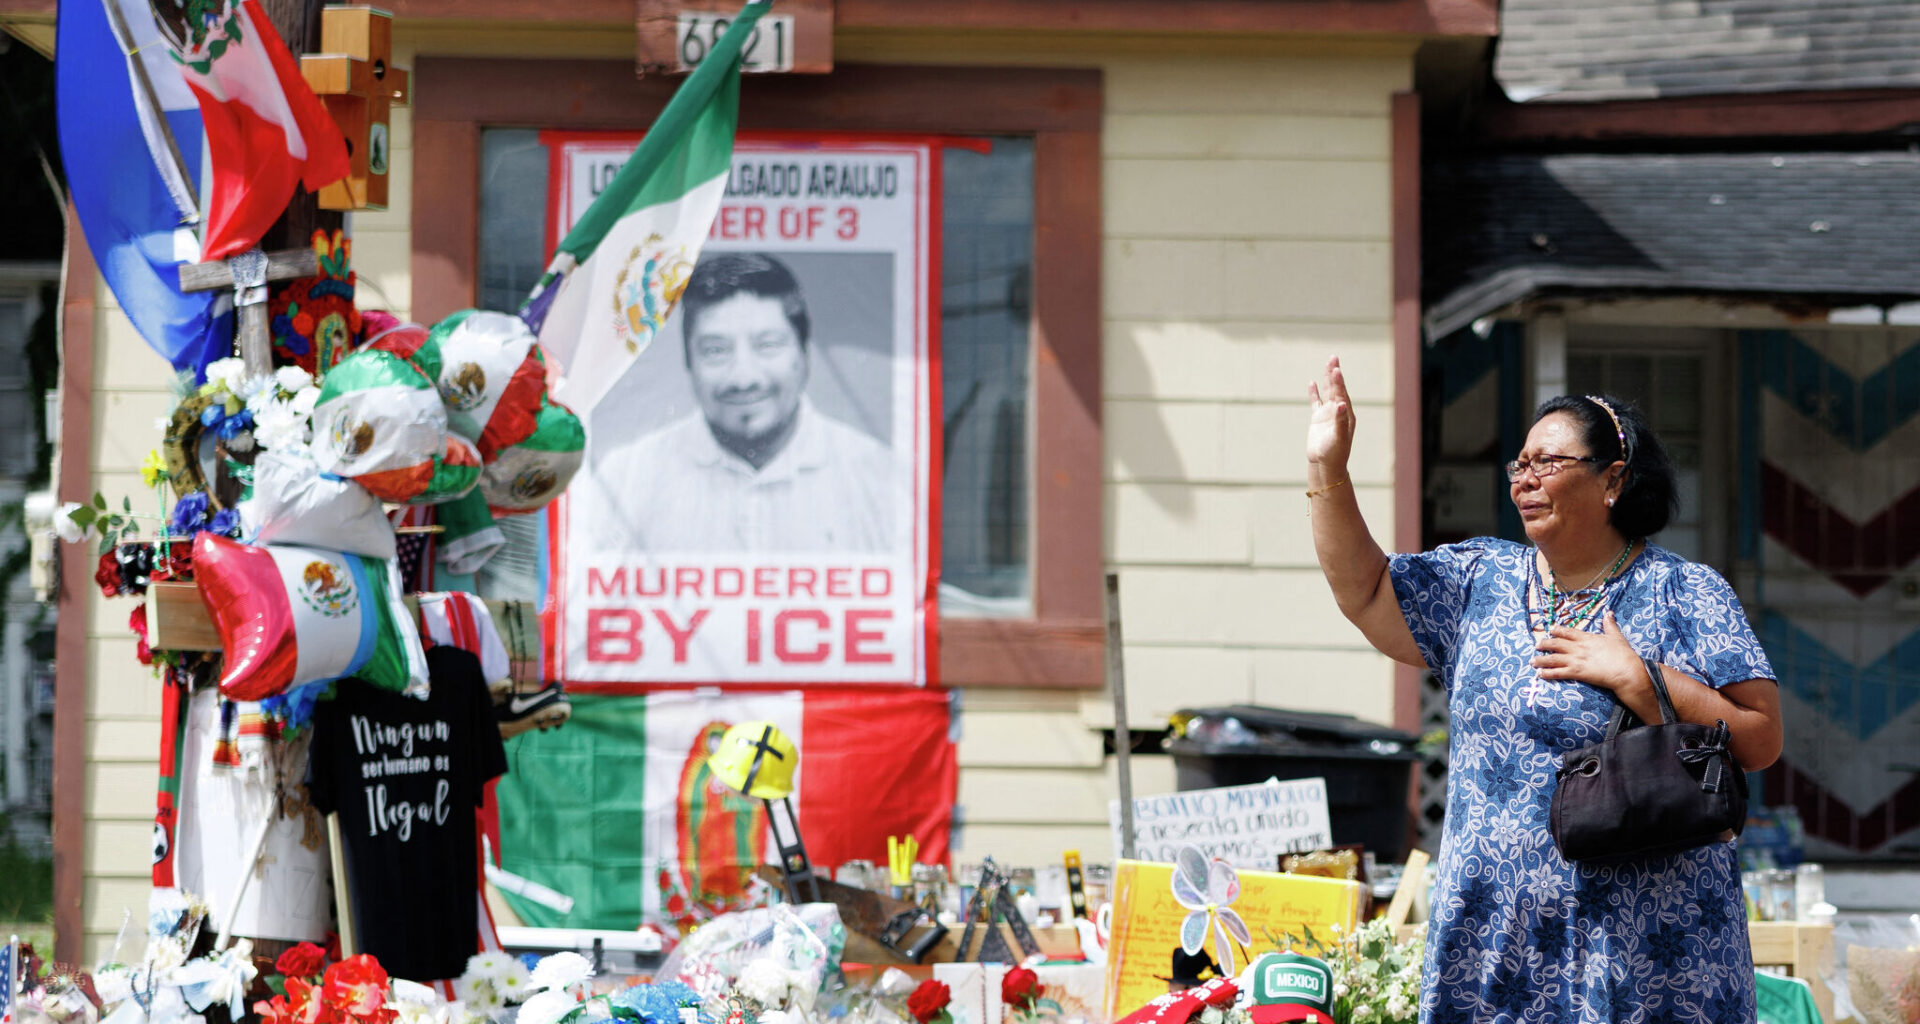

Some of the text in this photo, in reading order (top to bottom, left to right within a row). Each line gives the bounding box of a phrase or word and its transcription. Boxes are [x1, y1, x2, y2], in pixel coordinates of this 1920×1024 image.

[808, 164, 897, 198] ARAUJO
[779, 207, 825, 240] OF
[837, 207, 859, 240] 3
[587, 567, 892, 598] MURDERED
[587, 608, 894, 665] BY ICE
[350, 714, 450, 758] Ningun
[433, 754, 450, 772] es
[363, 778, 451, 842] Ilegal
[1276, 972, 1319, 992] MEXICO
